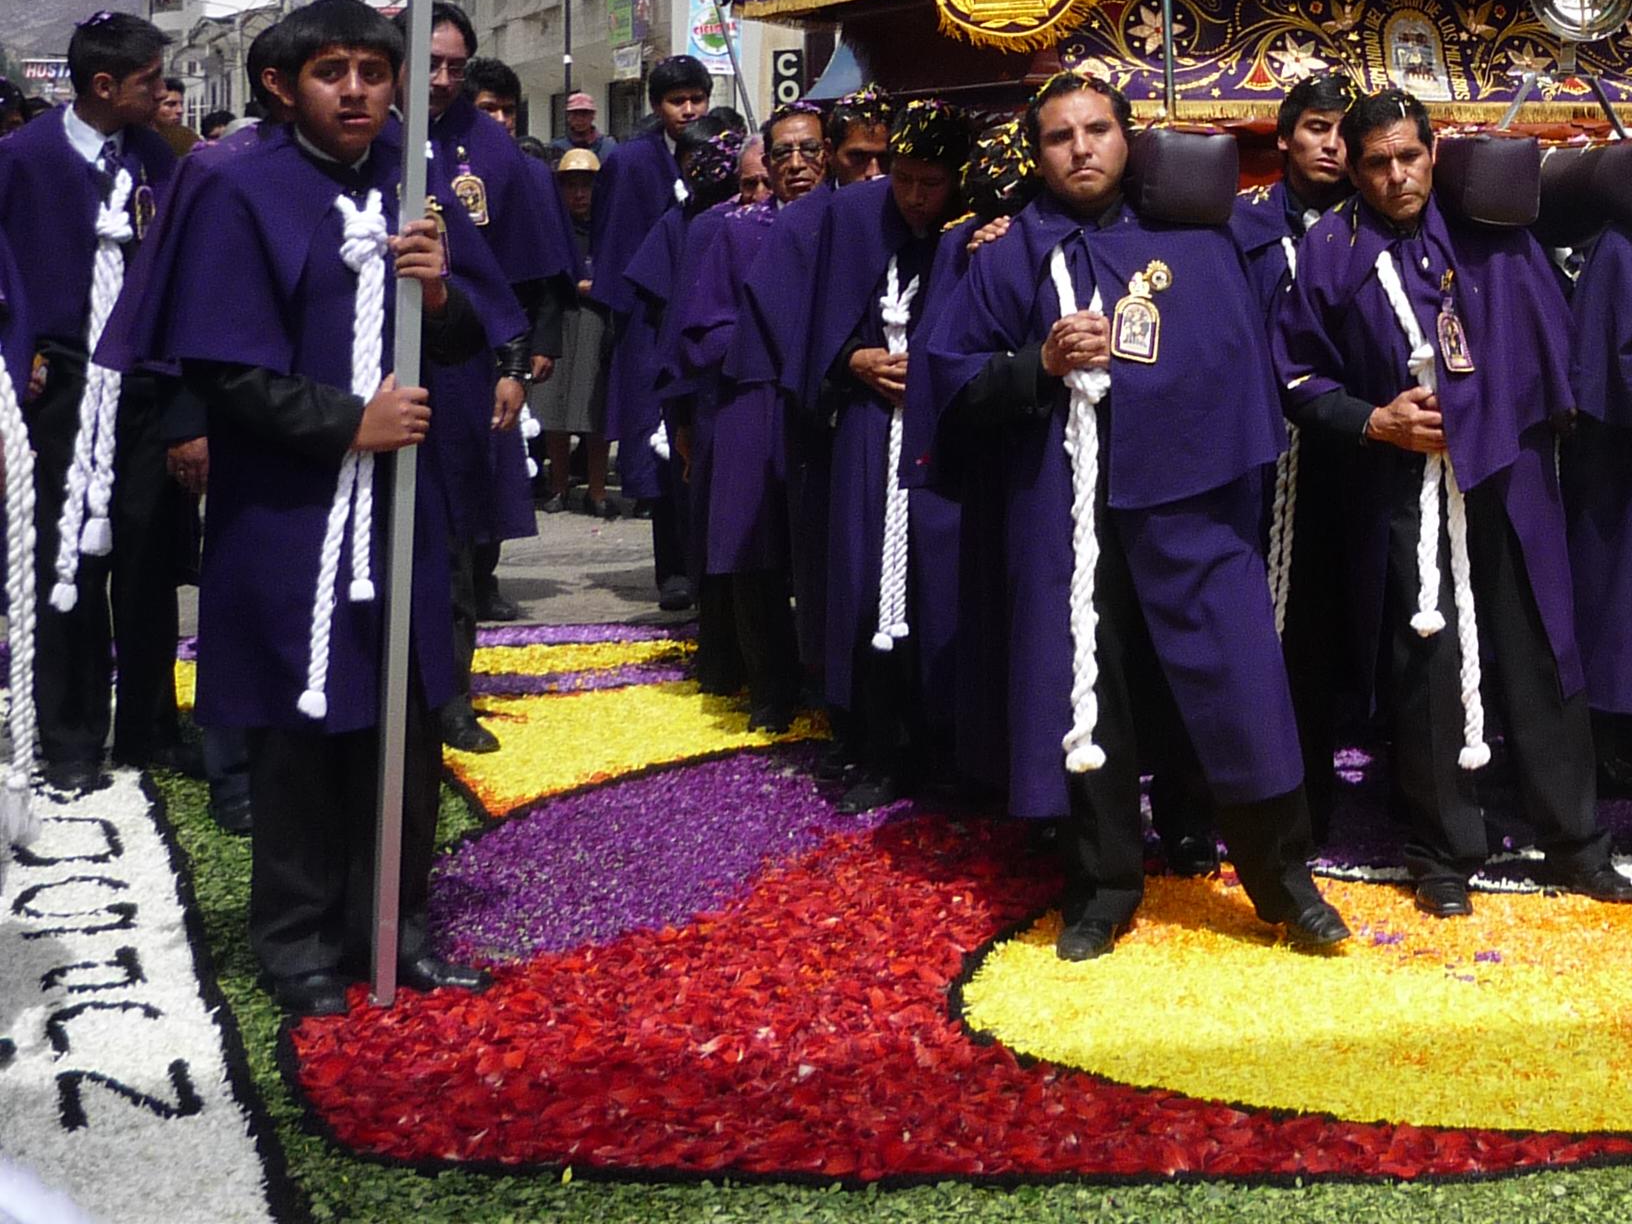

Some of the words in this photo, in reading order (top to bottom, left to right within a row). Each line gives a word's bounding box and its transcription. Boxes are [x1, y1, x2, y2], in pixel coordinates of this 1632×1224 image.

[1438, 16, 1459, 42] LOS
[1363, 31, 1389, 91] ERMANDAD
[1444, 44, 1471, 101] MILAGROS
